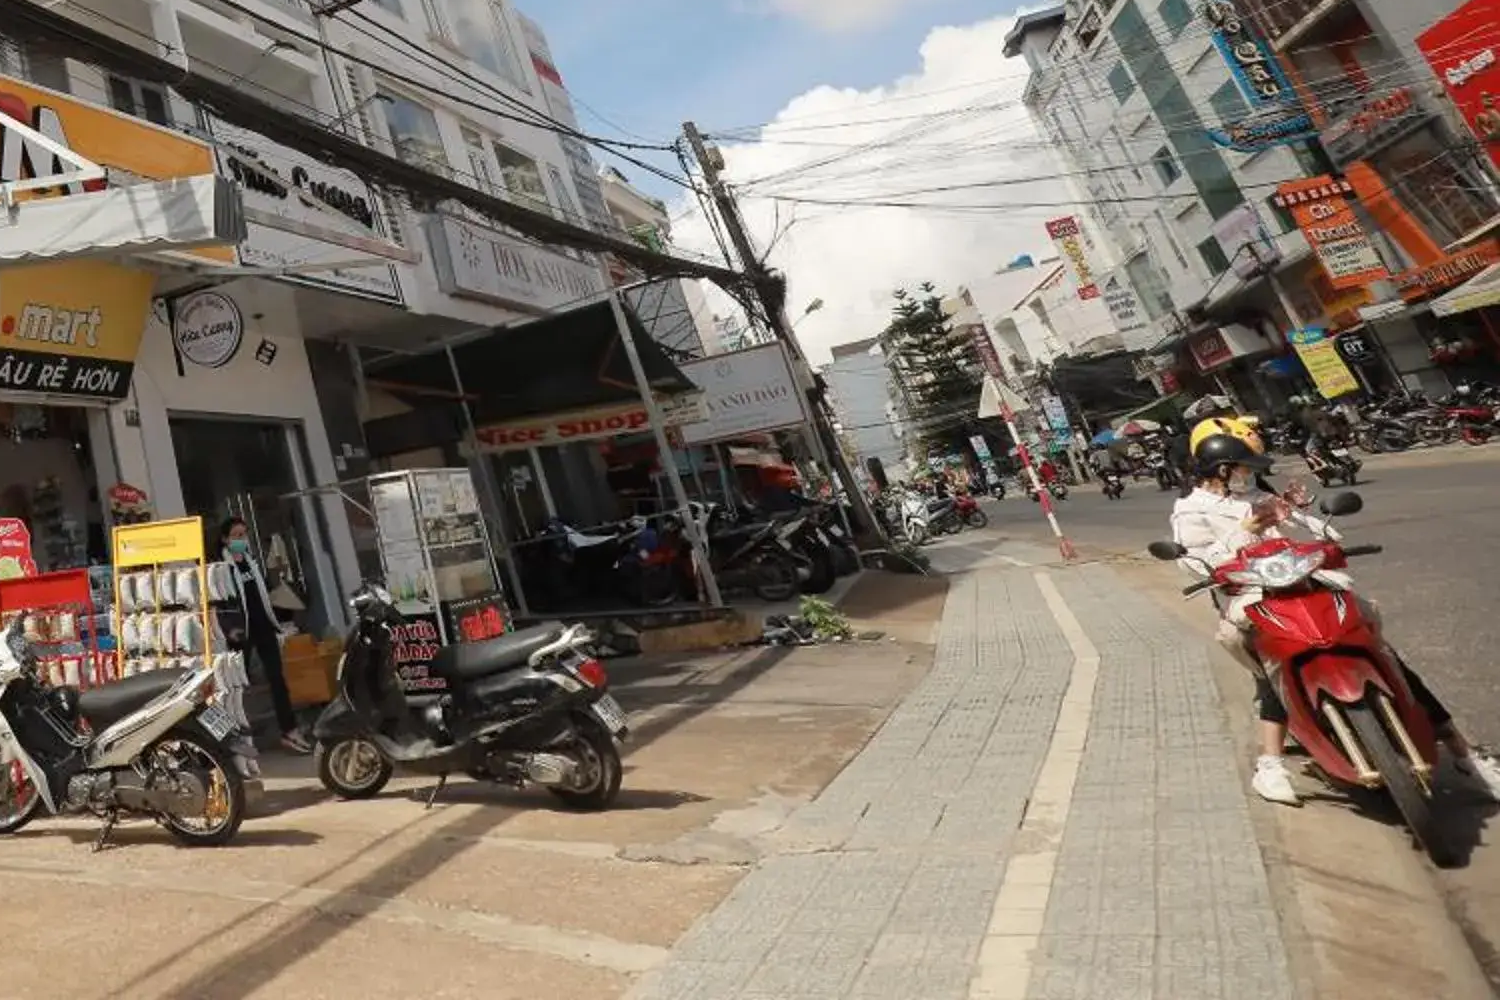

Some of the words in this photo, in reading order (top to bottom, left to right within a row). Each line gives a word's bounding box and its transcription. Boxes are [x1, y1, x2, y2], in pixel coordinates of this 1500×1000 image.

[36, 357, 68, 388] RẺ
[73, 364, 120, 393] HƠN
[557, 409, 648, 438] Shop
